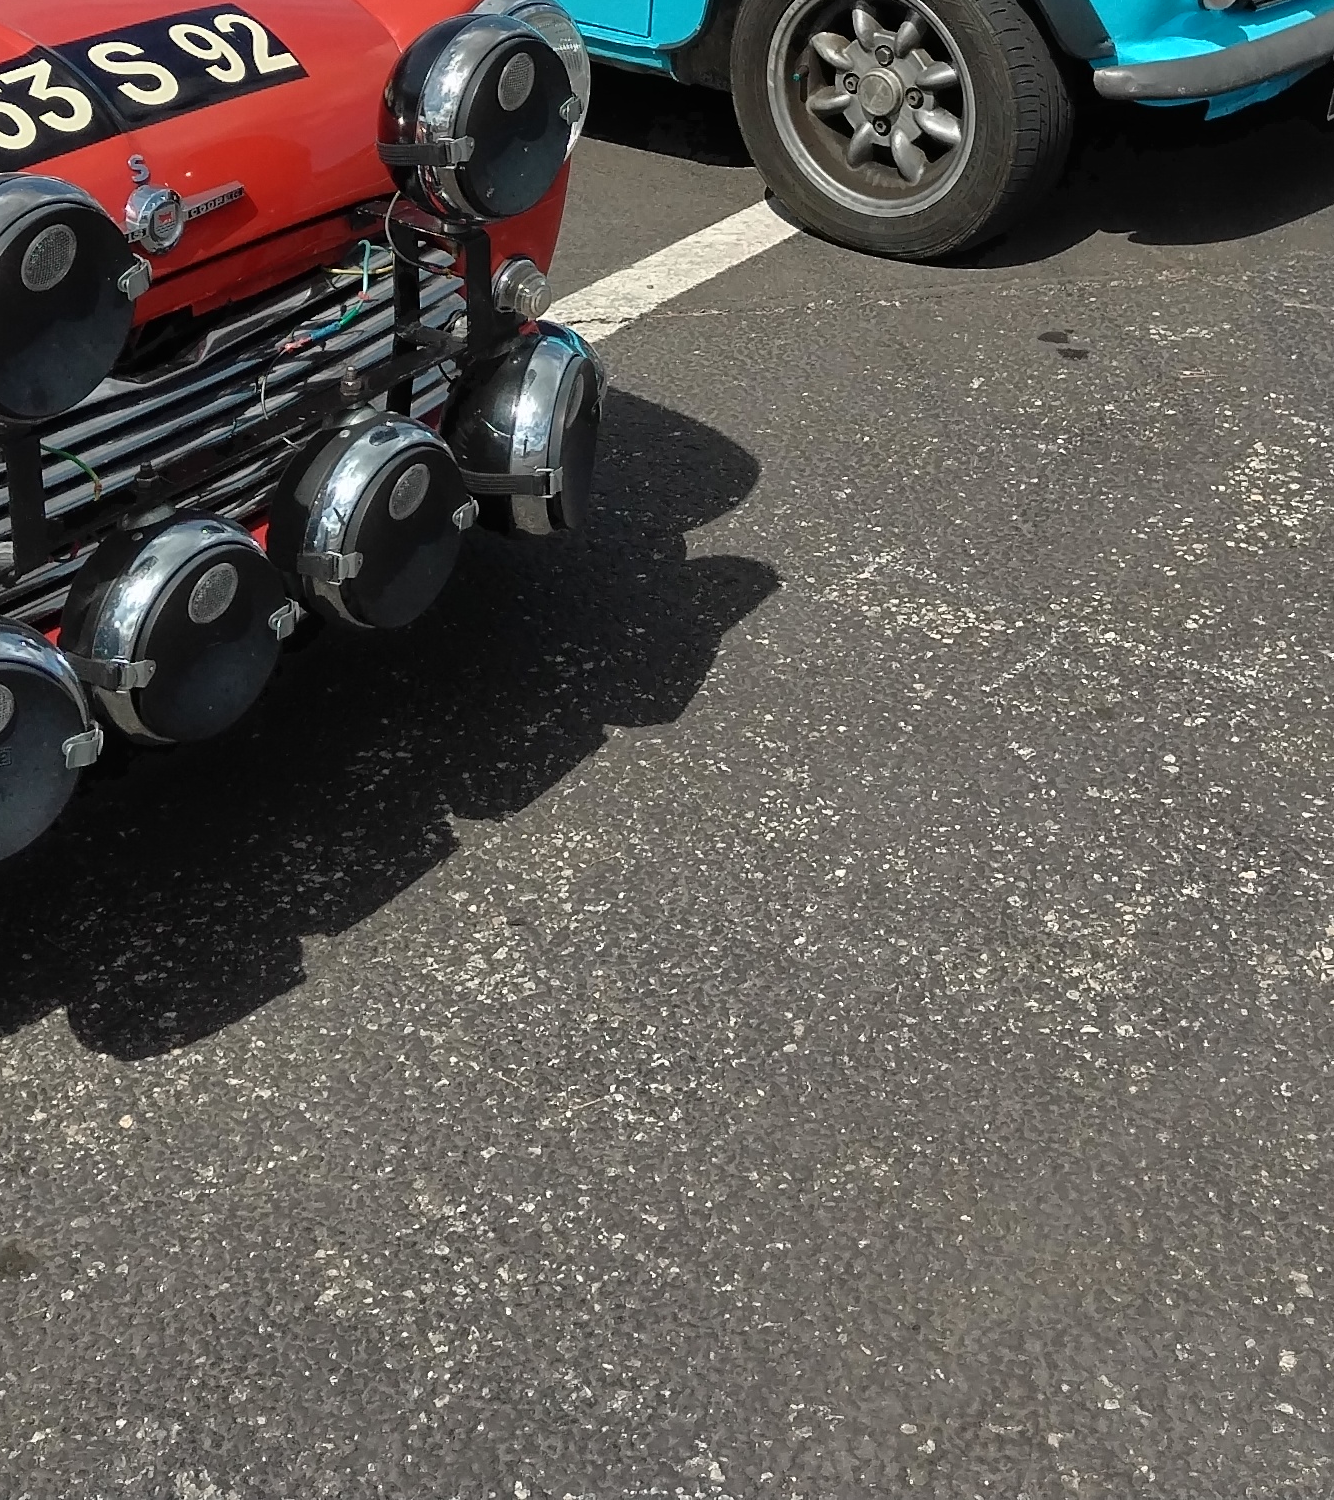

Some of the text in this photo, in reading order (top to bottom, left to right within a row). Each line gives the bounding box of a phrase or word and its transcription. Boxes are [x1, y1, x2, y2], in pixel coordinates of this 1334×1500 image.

[87, 41, 179, 105] S
[168, 13, 299, 83] 92
[127, 154, 150, 182] S
